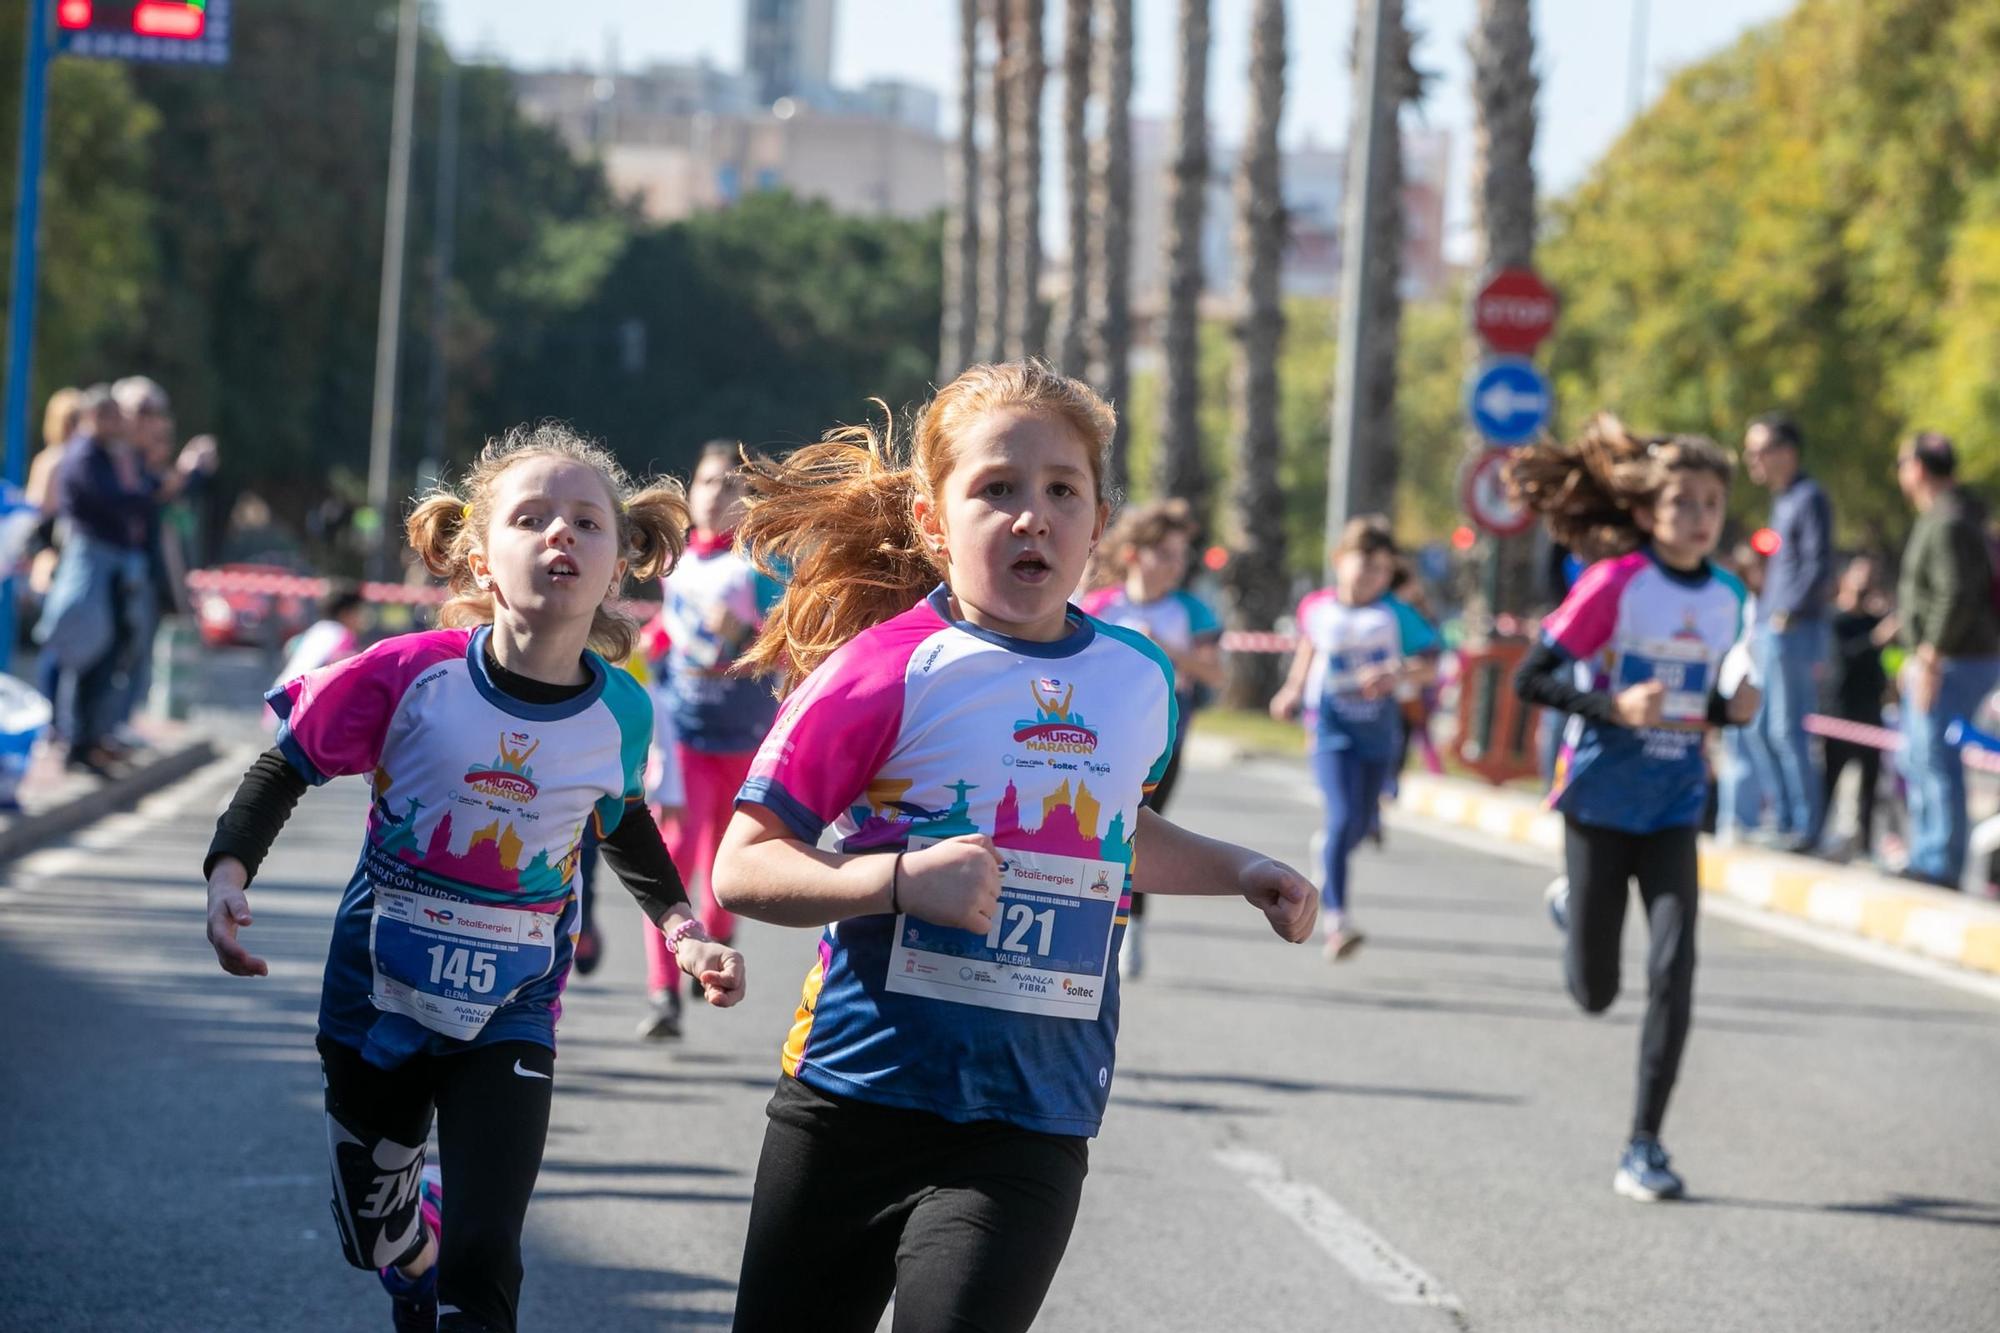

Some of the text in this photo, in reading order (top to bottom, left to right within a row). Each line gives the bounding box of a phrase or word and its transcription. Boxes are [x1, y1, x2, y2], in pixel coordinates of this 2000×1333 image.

[1038, 731, 1094, 746] MURCIA
[485, 778, 535, 797] MURCIA
[1013, 868, 1075, 886] TotalEnergies
[456, 916, 512, 934] TotalEnergies
[985, 902, 1055, 957] 121
[994, 952, 1032, 967] VALERIA
[427, 944, 498, 994] 145
[1010, 972, 1055, 986] AVANZA
[443, 988, 469, 1001] ELENA
[1018, 983, 1047, 994] FIBRA
[1066, 985, 1094, 998] soltec
[460, 1014, 487, 1025] FIBRA
